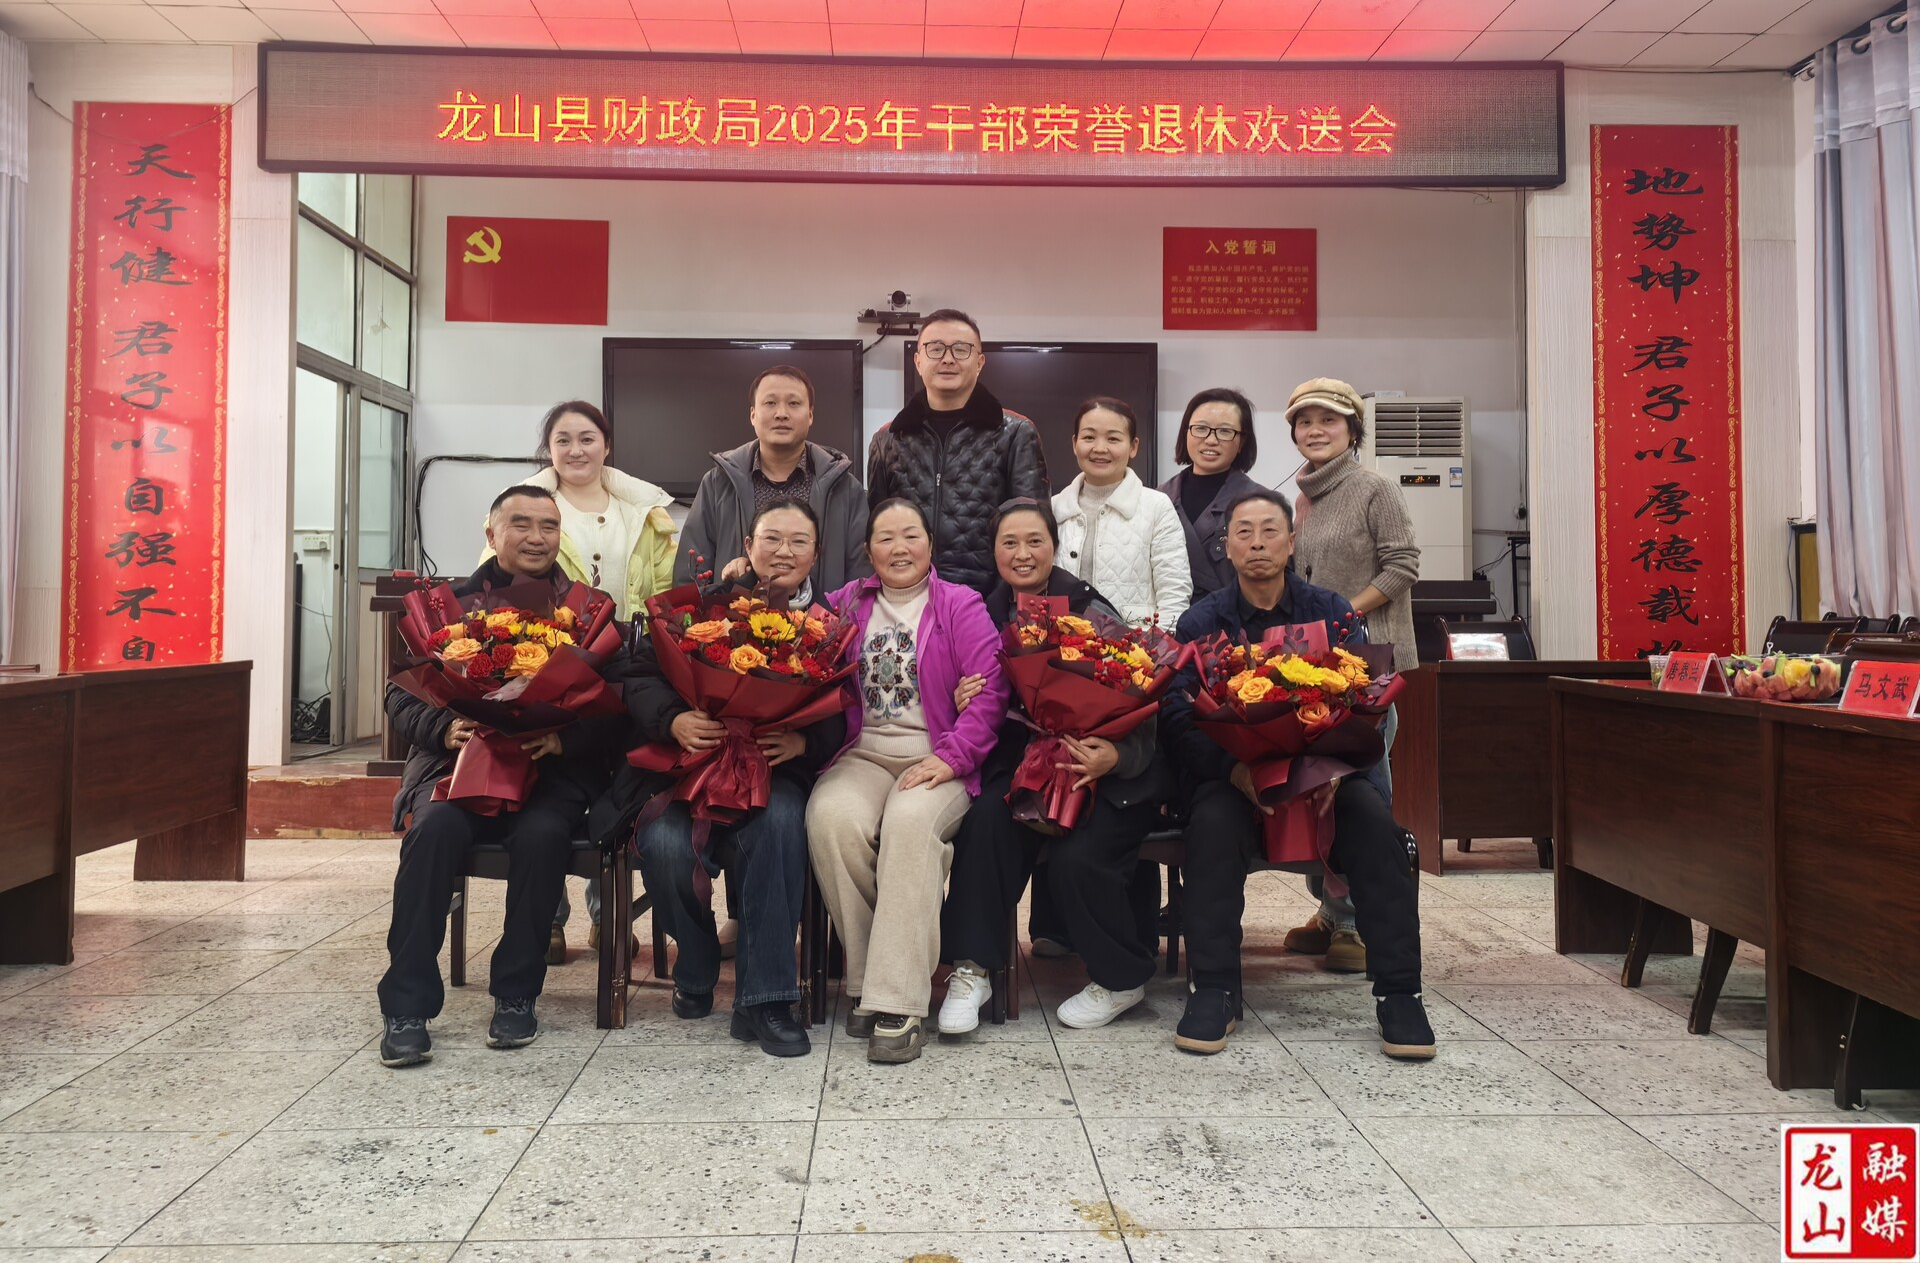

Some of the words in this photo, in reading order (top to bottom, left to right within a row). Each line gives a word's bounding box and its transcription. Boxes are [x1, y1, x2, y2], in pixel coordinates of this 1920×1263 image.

[437, 90, 1397, 154] 龙山县财政局2025年干部荣誉退休欢送会
[1205, 239, 1276, 255] 入党誓词
[1854, 673, 1911, 701] 马文武
